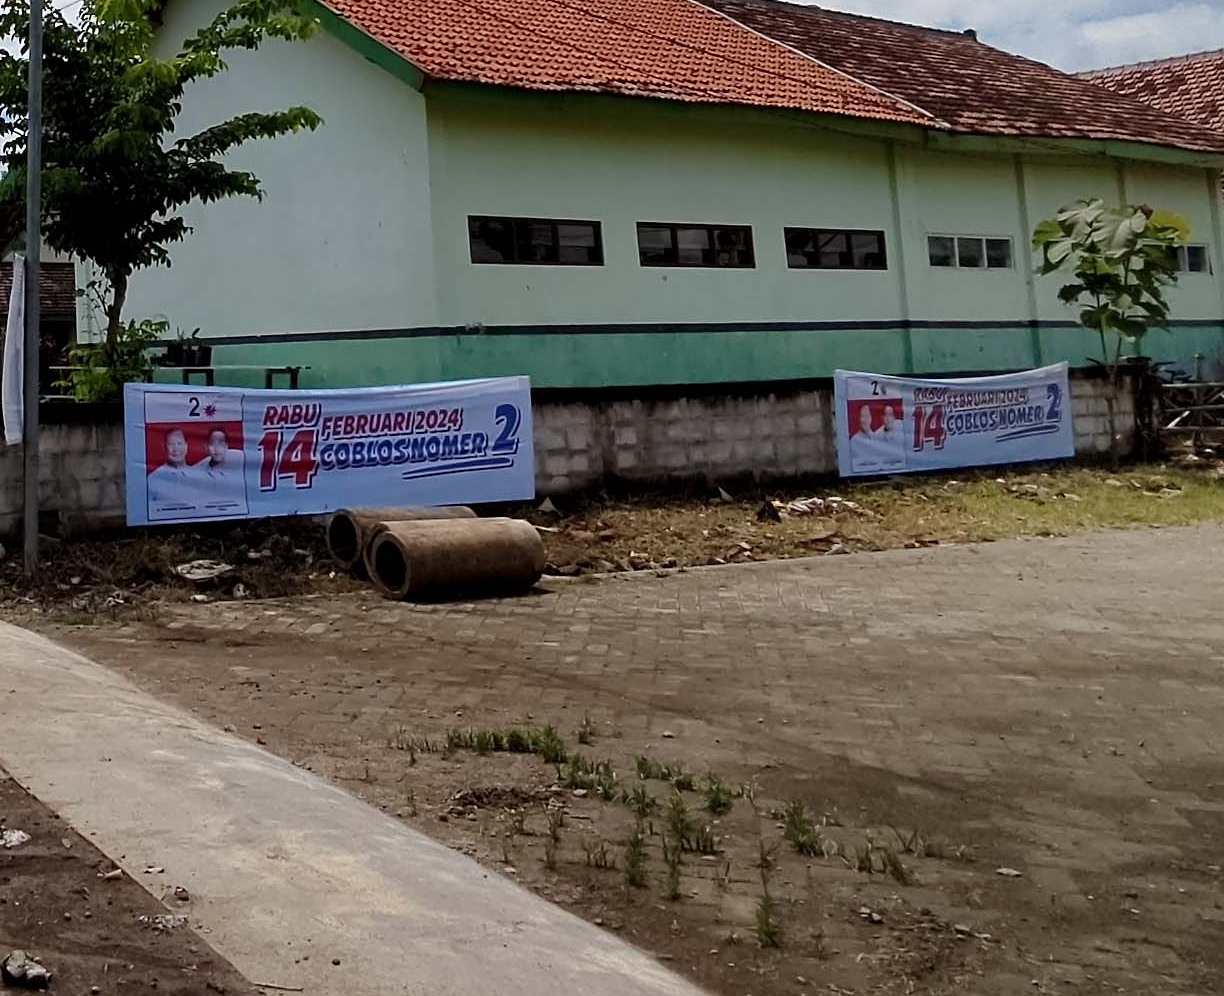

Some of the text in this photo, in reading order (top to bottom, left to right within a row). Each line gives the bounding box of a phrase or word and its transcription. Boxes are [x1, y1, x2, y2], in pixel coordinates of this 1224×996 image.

[871, 380, 879, 396] 2
[1045, 383, 1062, 423] 2
[188, 396, 201, 418] 2
[262, 403, 321, 428] RABU
[321, 407, 463, 440] FEBRUARI 2024
[319, 403, 521, 470] COBLOS NOMER 2
[912, 405, 947, 452] 14
[257, 429, 319, 491] 14
